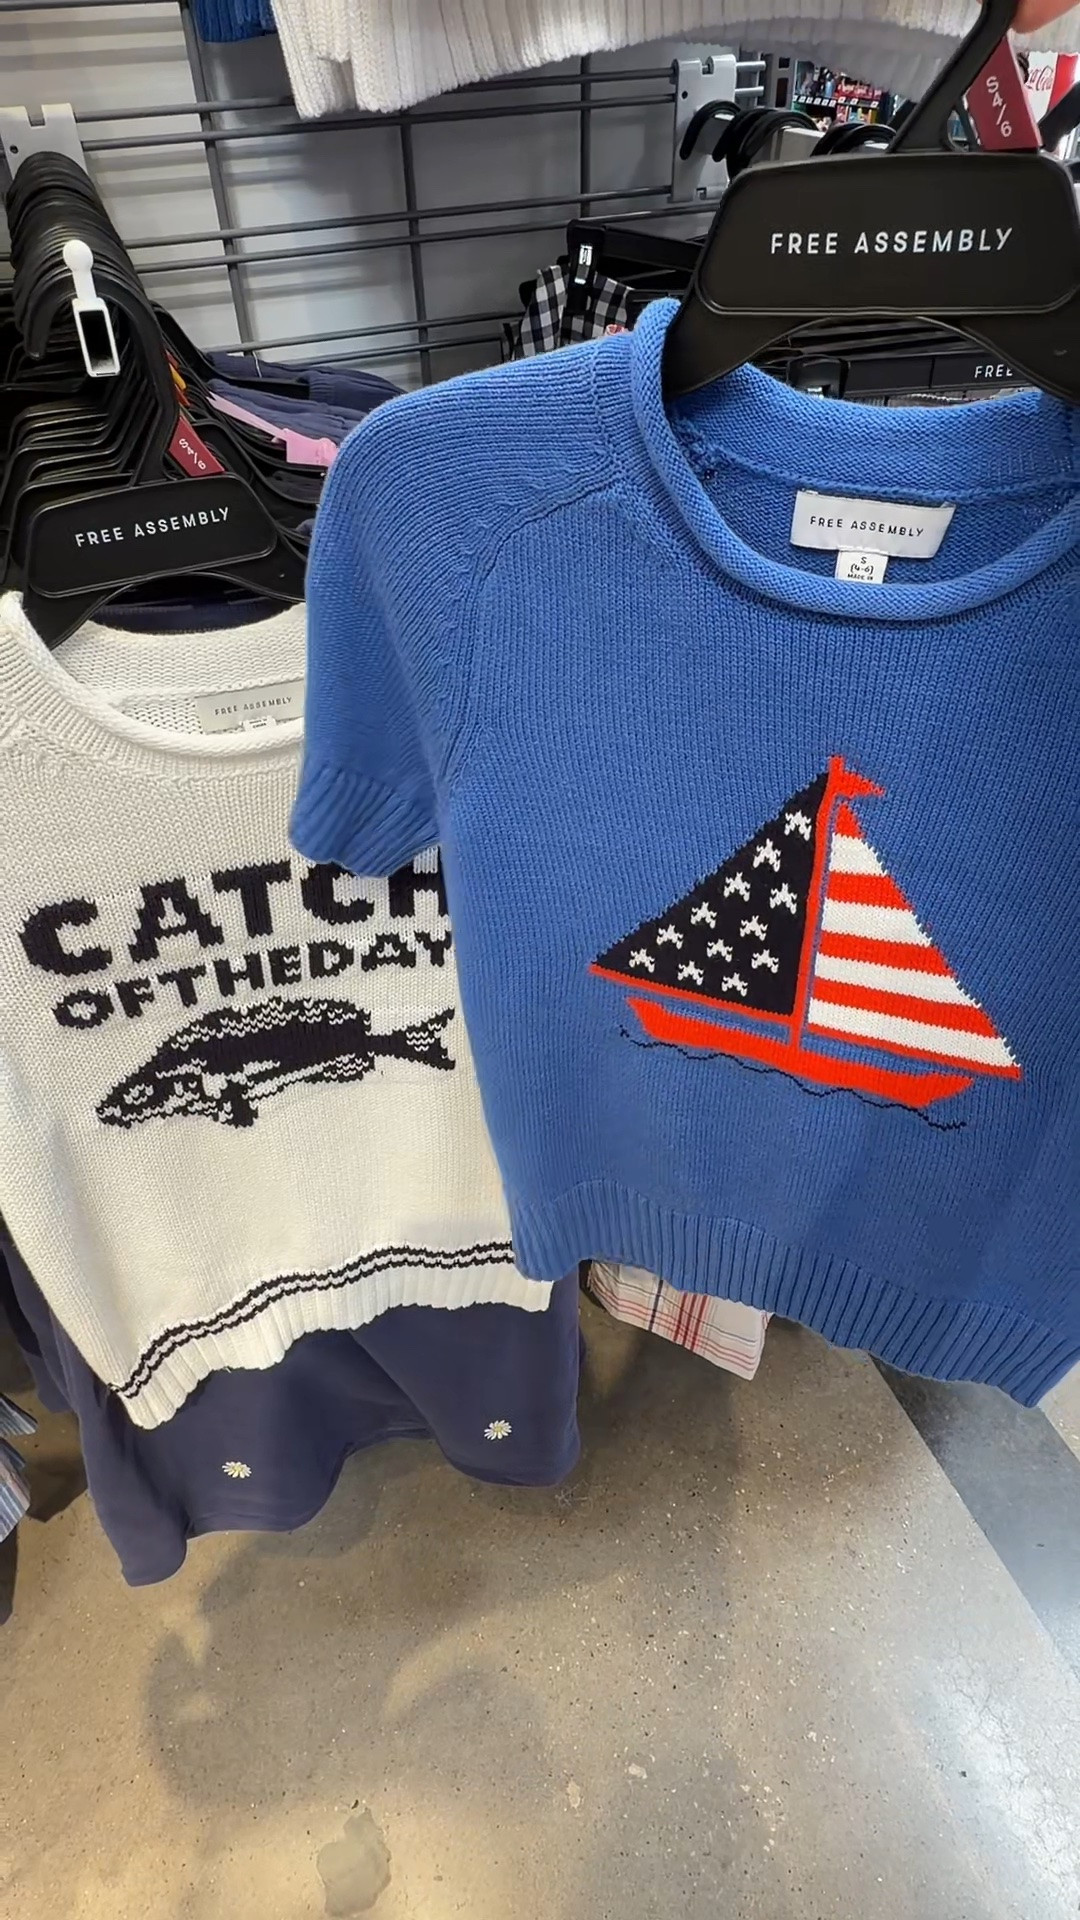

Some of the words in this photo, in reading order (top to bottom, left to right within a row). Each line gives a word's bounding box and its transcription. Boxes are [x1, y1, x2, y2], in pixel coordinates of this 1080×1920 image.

[770, 232, 839, 256] FREE
[853, 227, 1014, 254] ASSEMBLY
[75, 526, 125, 548] FREE
[134, 506, 229, 538] ASSEMBLY
[810, 515, 843, 528] FREE
[850, 520, 925, 537] ASSEMBLY
[850, 563, 875, 575] (4-6)
[860, 556, 868, 565] S
[214, 705, 238, 716] FREE
[243, 696, 293, 711] ASSEMBLY
[19, 847, 450, 977] CATCH
